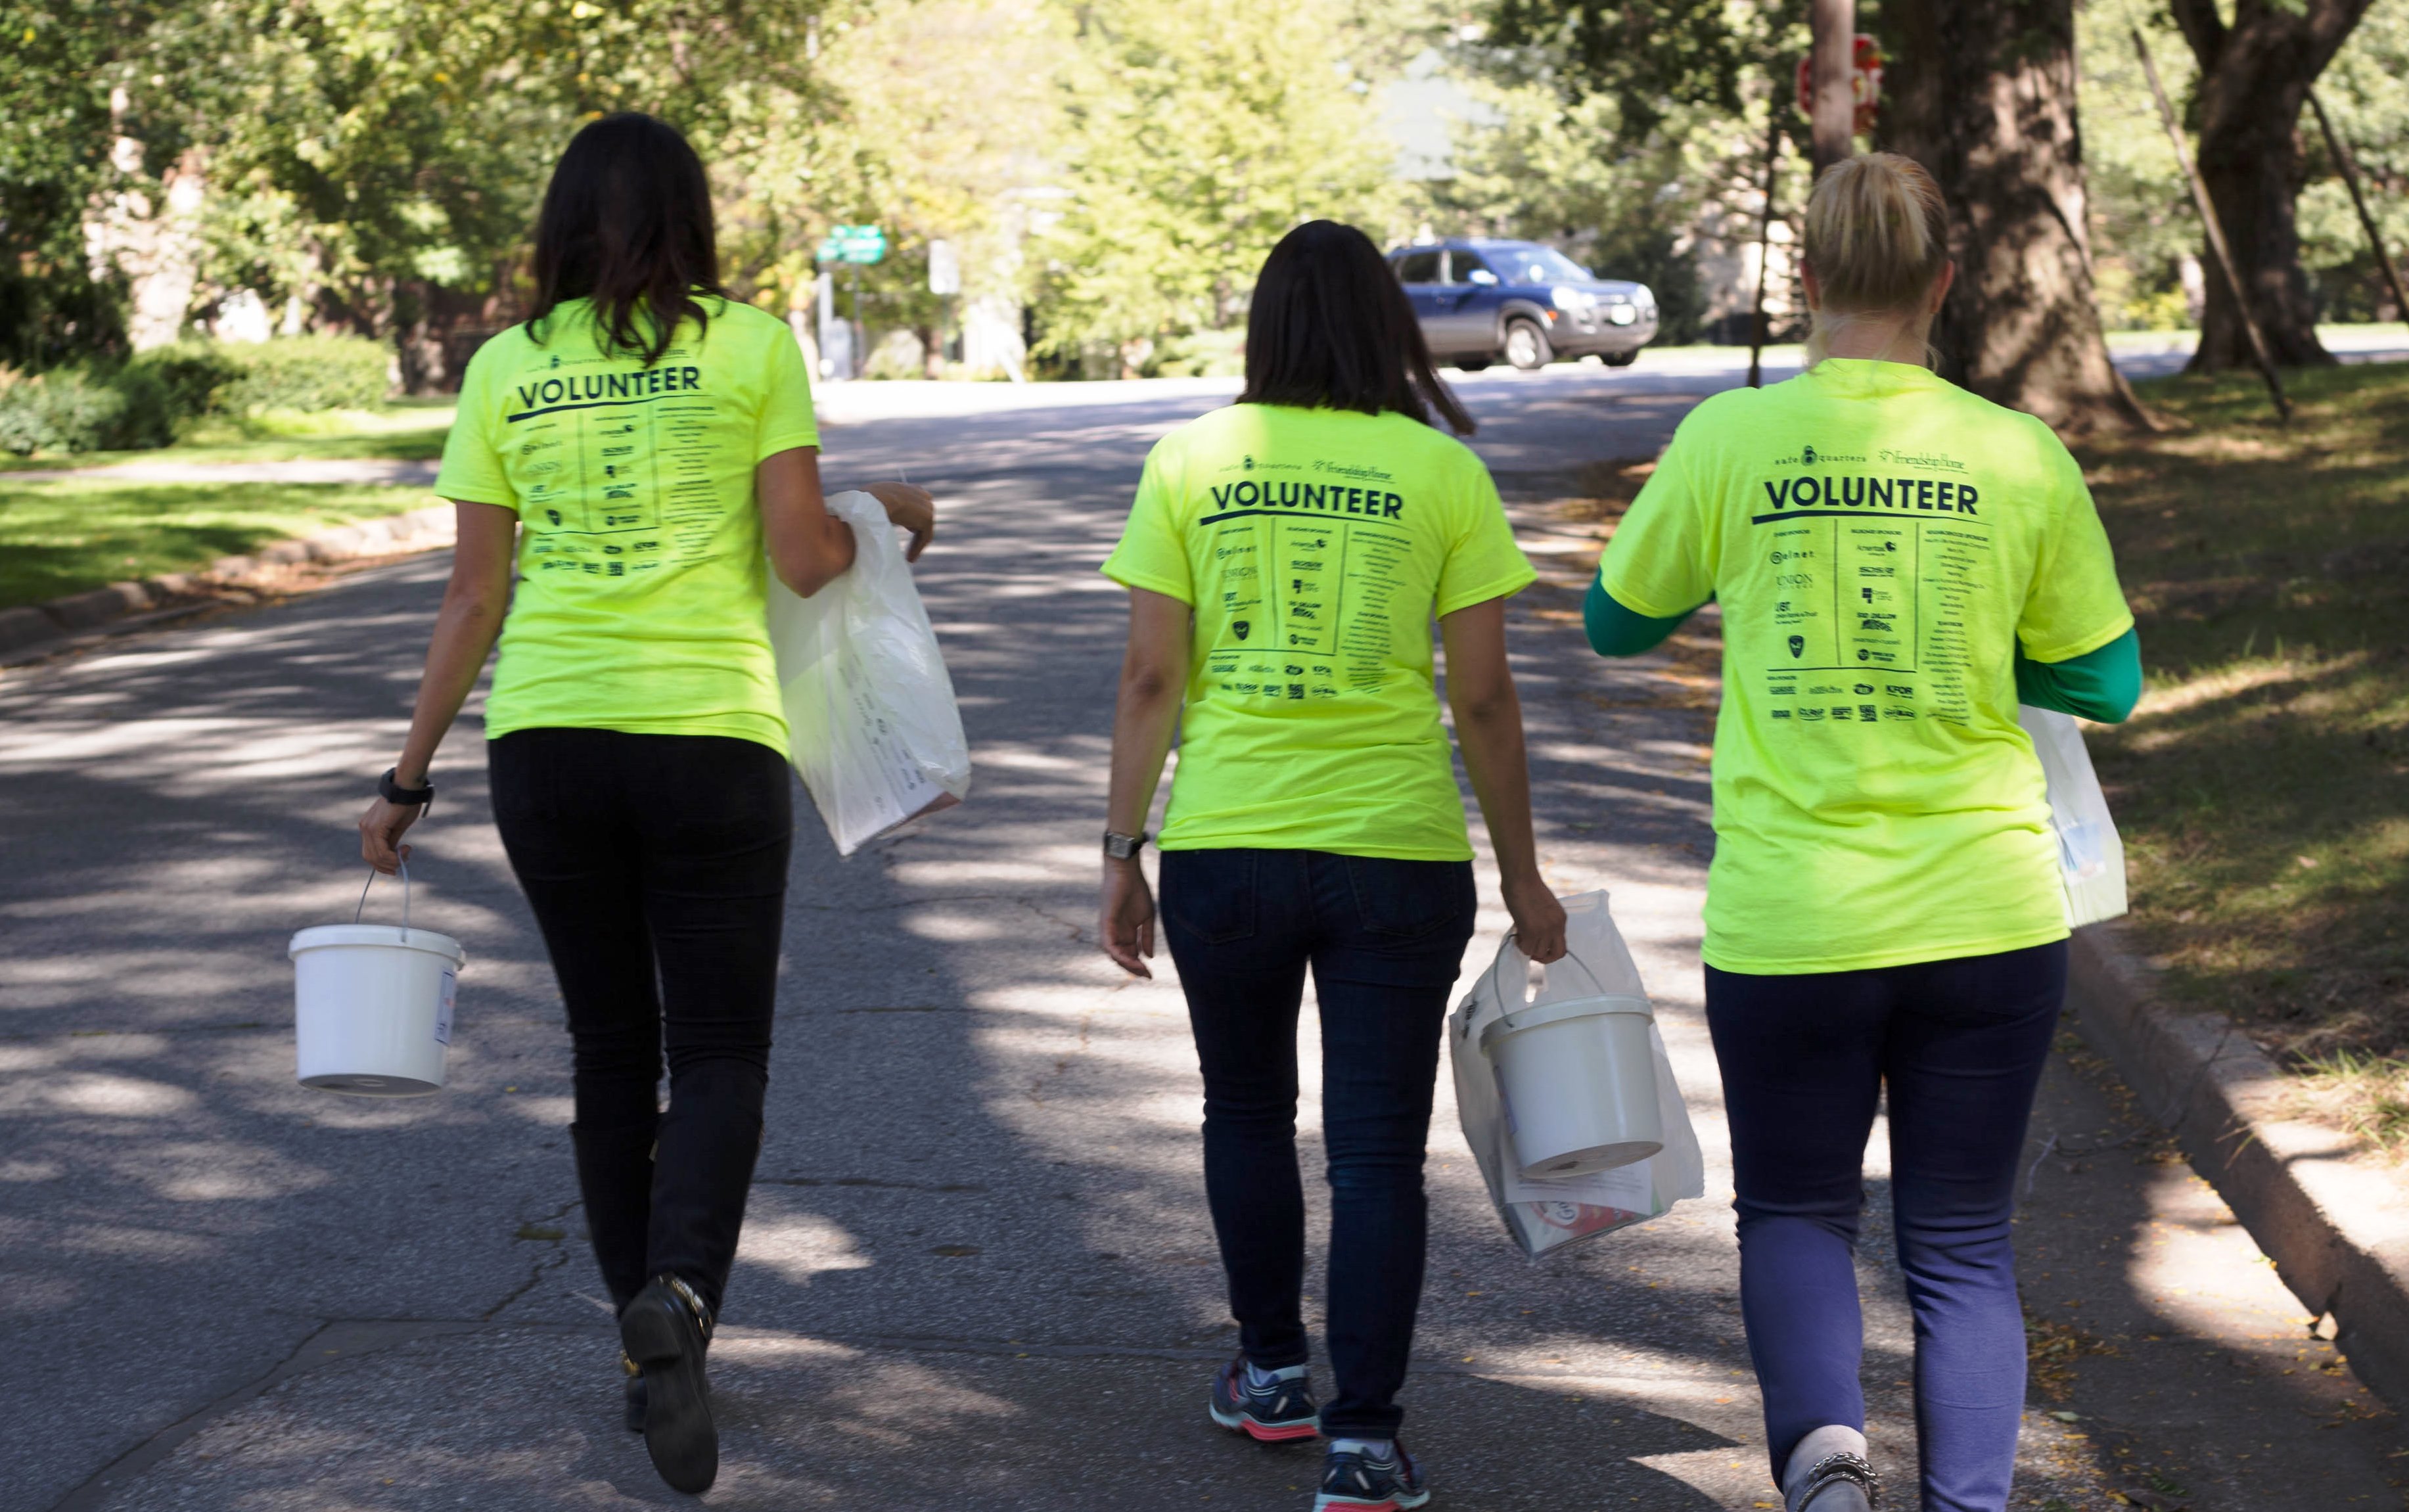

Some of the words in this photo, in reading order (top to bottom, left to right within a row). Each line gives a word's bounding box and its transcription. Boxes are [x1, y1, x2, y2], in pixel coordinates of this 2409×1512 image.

[518, 367, 699, 408] VOLUNTEER
[1211, 482, 1402, 520] VOLUNTEER
[1764, 476, 1978, 515] VOLUNTEER
